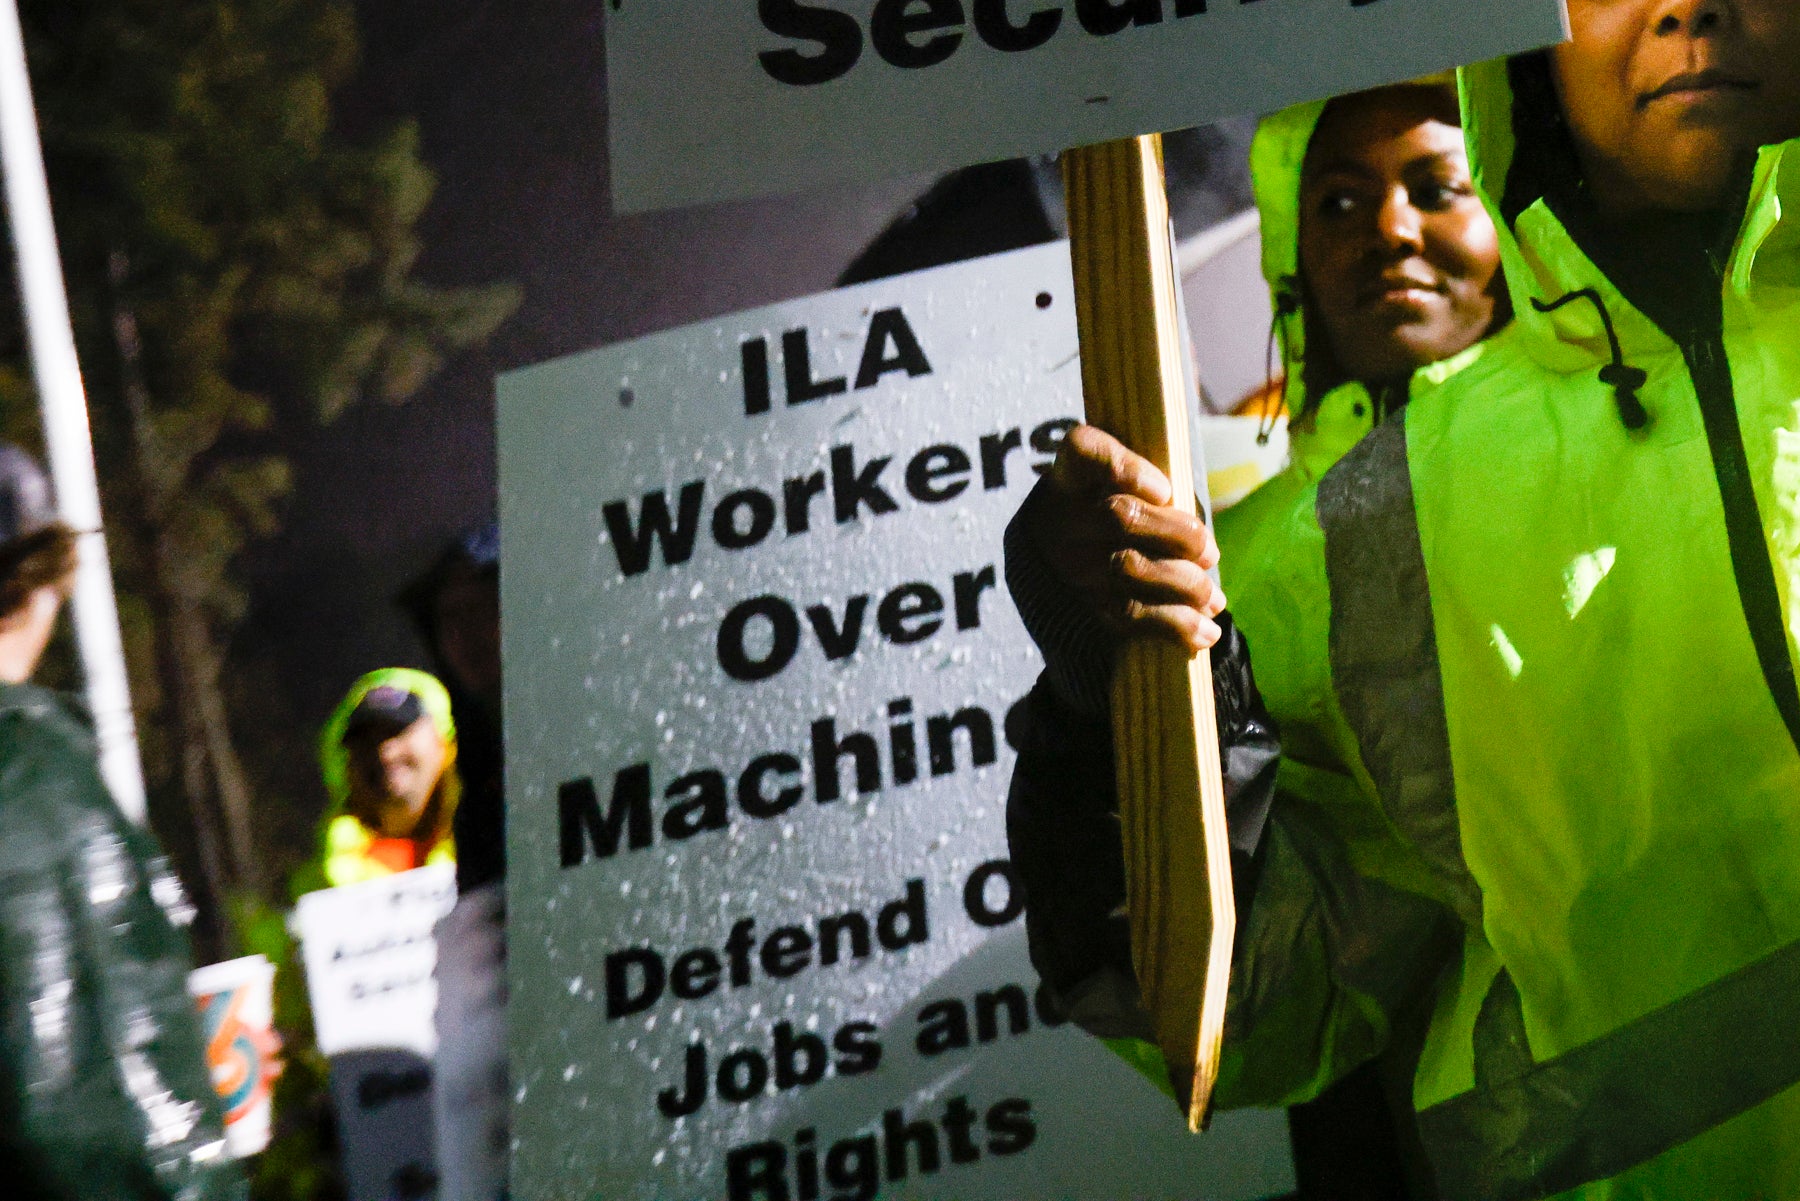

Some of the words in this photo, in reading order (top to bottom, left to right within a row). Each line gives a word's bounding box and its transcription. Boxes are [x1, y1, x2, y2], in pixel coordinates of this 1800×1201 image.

[739, 306, 932, 417] ILA
[715, 564, 996, 684] Over
[556, 690, 1026, 871] Machin
[602, 878, 930, 1024] Defend
[656, 1015, 884, 1122] Jobs
[725, 1094, 1038, 1201] Rights
